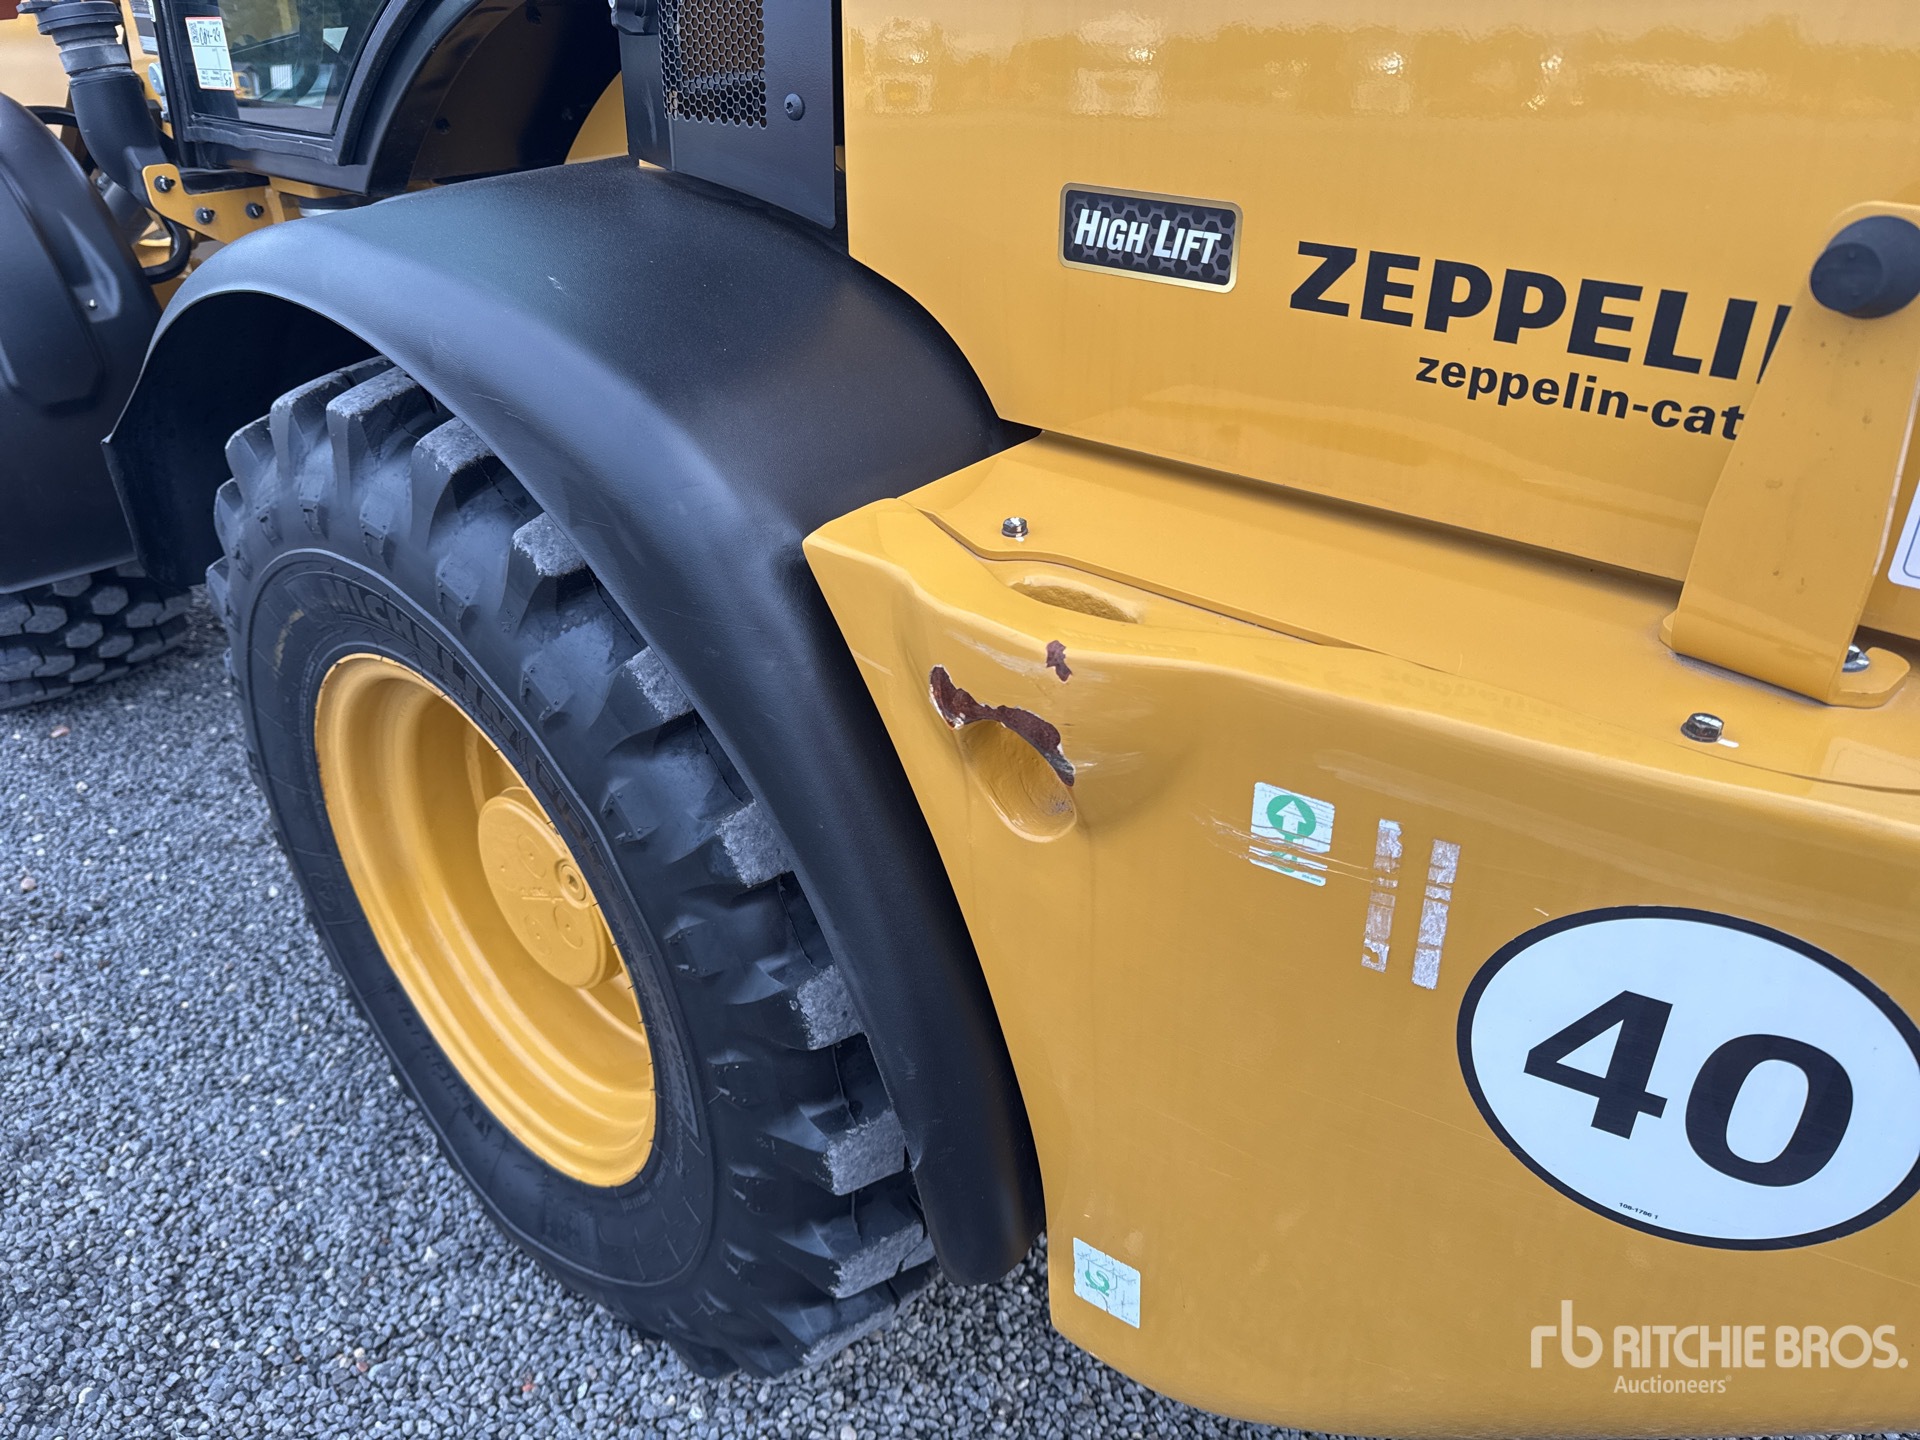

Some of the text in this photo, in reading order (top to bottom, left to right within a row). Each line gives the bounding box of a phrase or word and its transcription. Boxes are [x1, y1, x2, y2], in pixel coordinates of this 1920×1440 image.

[1074, 208, 1222, 264] HIGH LIFT
[1415, 357, 1745, 440] zeppelin-cat
[1523, 990, 1853, 1187] 40
